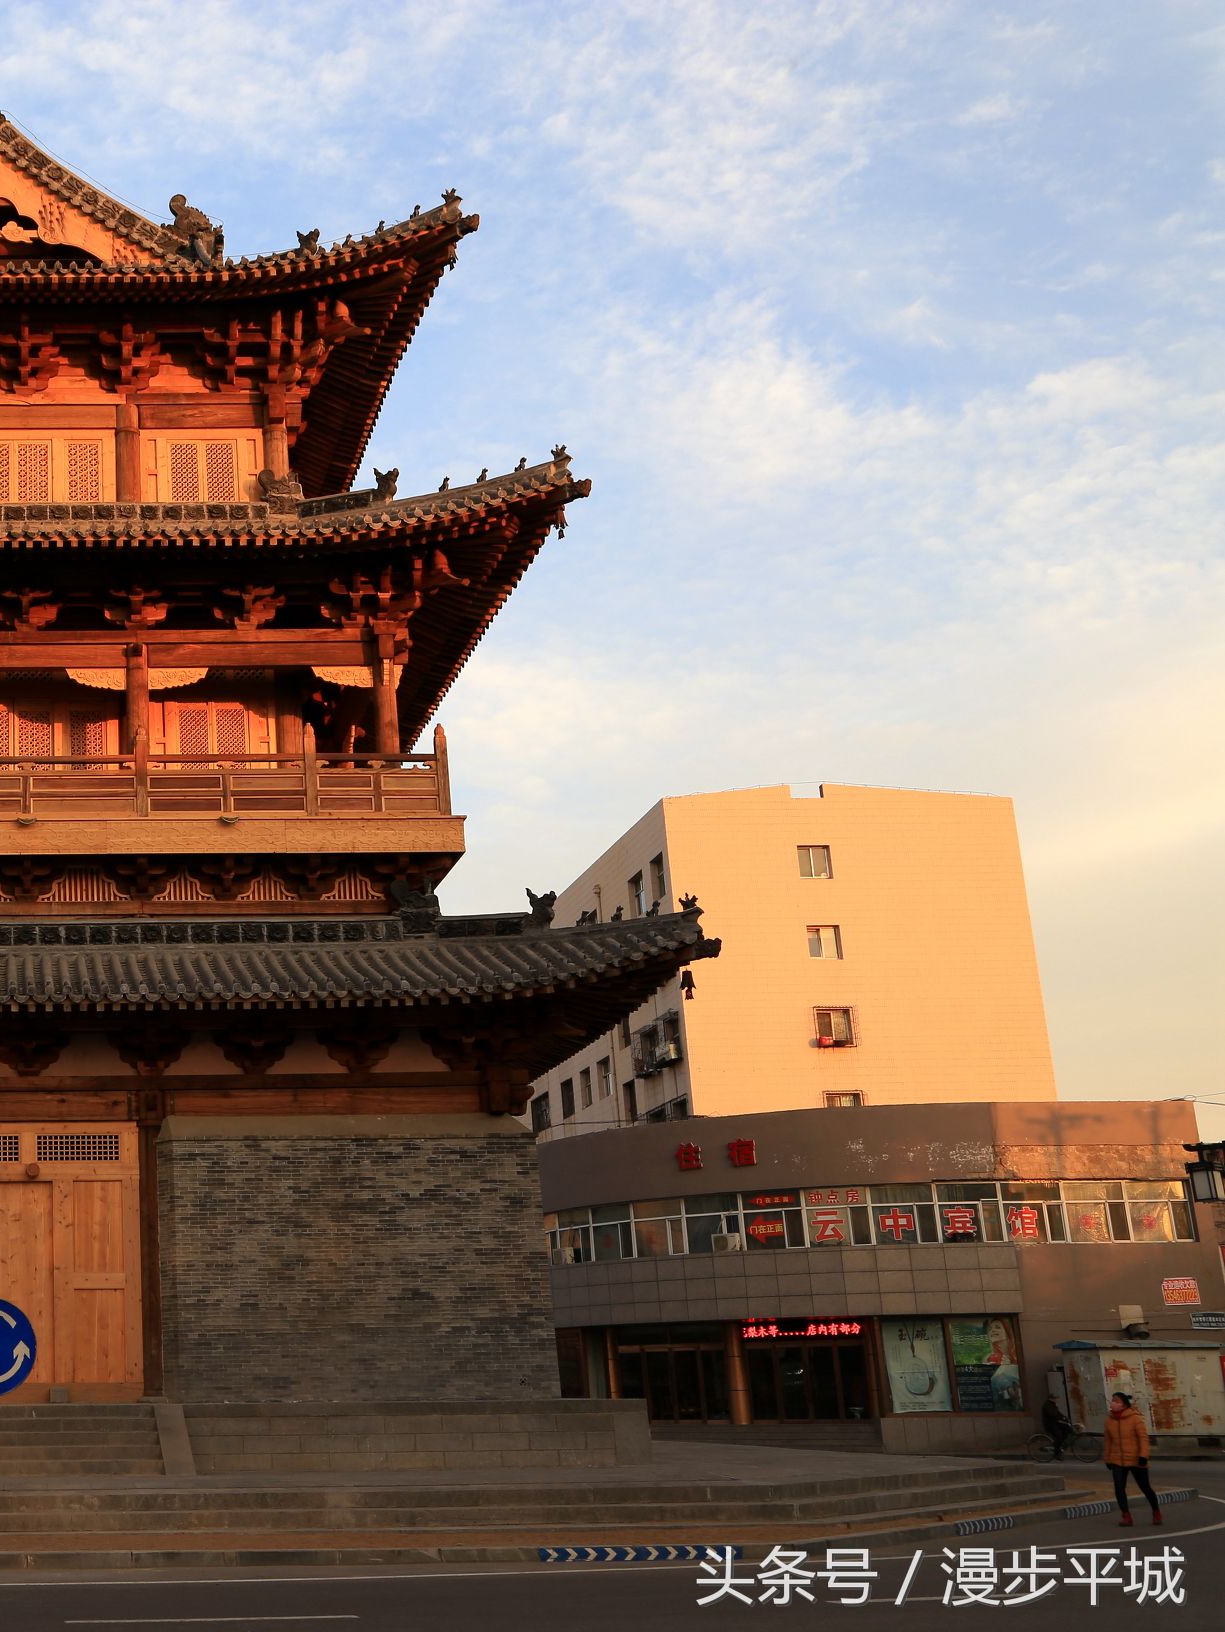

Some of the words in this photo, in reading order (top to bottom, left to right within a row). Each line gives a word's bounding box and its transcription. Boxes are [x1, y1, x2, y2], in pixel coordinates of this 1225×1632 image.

[676, 1138, 757, 1170] 住宿
[808, 1189, 861, 1205] 钟点房
[749, 1223, 784, 1234] 门在正面
[811, 1206, 1039, 1244] 云中宾馆
